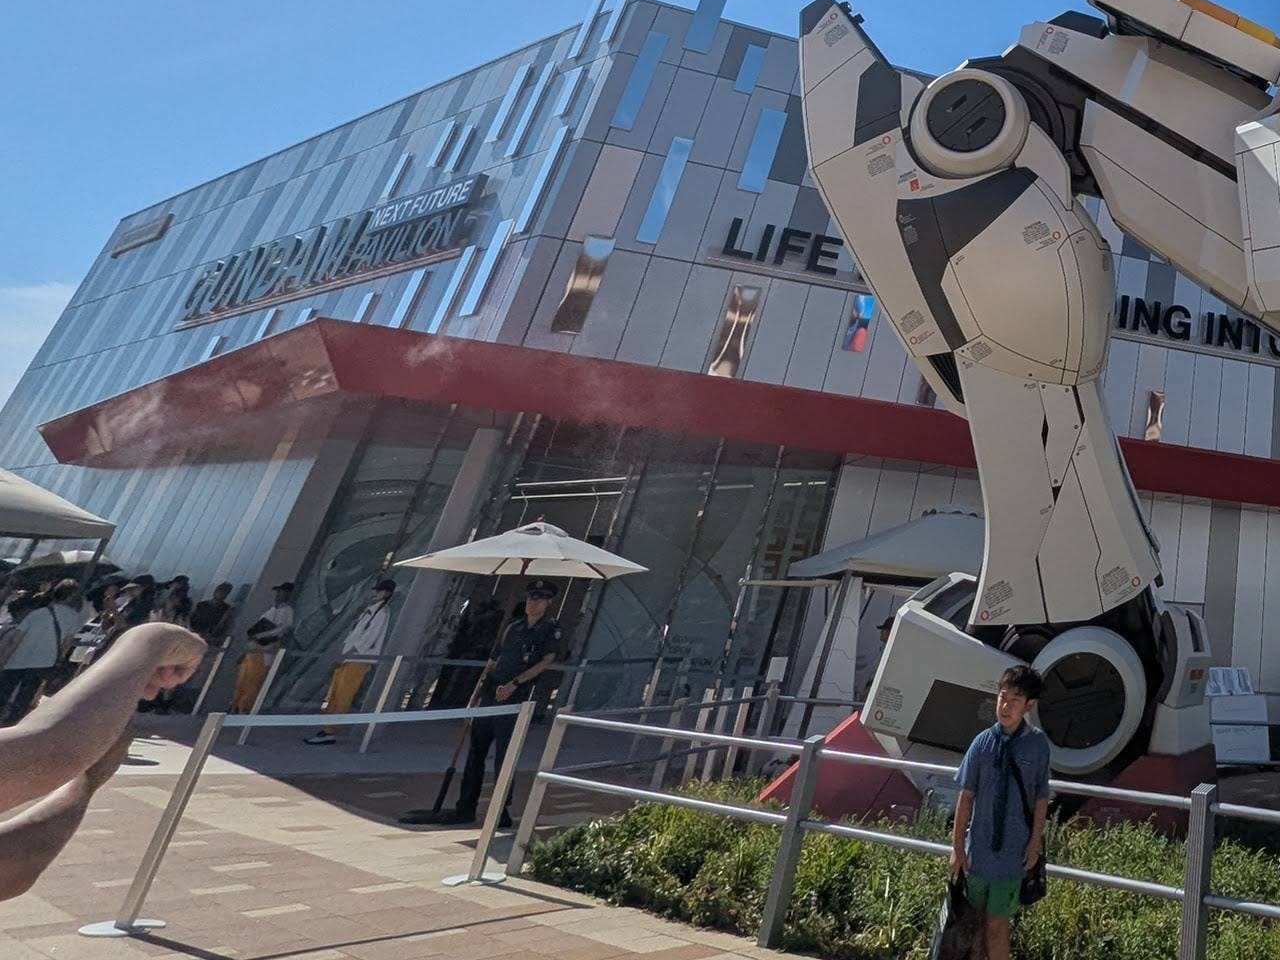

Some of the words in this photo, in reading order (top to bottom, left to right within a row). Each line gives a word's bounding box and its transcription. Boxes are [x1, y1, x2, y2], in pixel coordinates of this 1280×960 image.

[369, 199, 413, 230] NEXT
[408, 179, 474, 217] FUTURE
[183, 211, 374, 319] GUNDAM
[352, 207, 464, 272] PAVILION
[722, 217, 844, 276] LIFE
